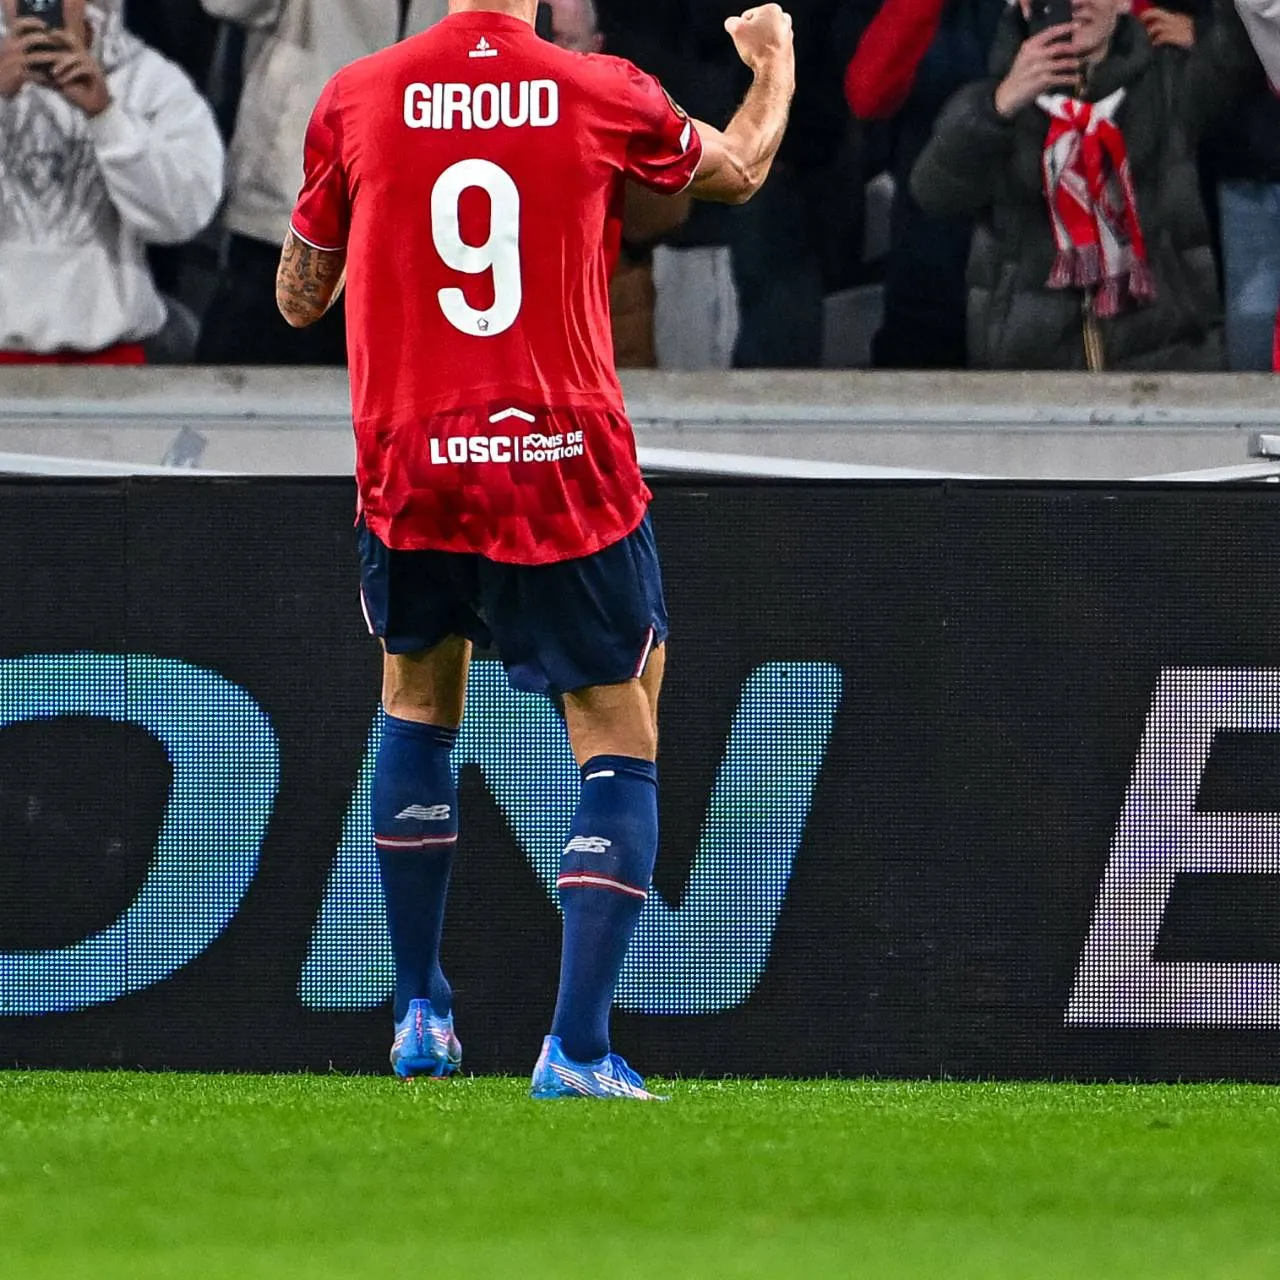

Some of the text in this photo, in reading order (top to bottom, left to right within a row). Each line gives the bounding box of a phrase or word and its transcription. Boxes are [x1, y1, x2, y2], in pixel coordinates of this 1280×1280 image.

[403, 79, 559, 130] GIROUD
[430, 158, 522, 337] 9
[430, 436, 511, 465] LOSC
[566, 430, 583, 444] DE
